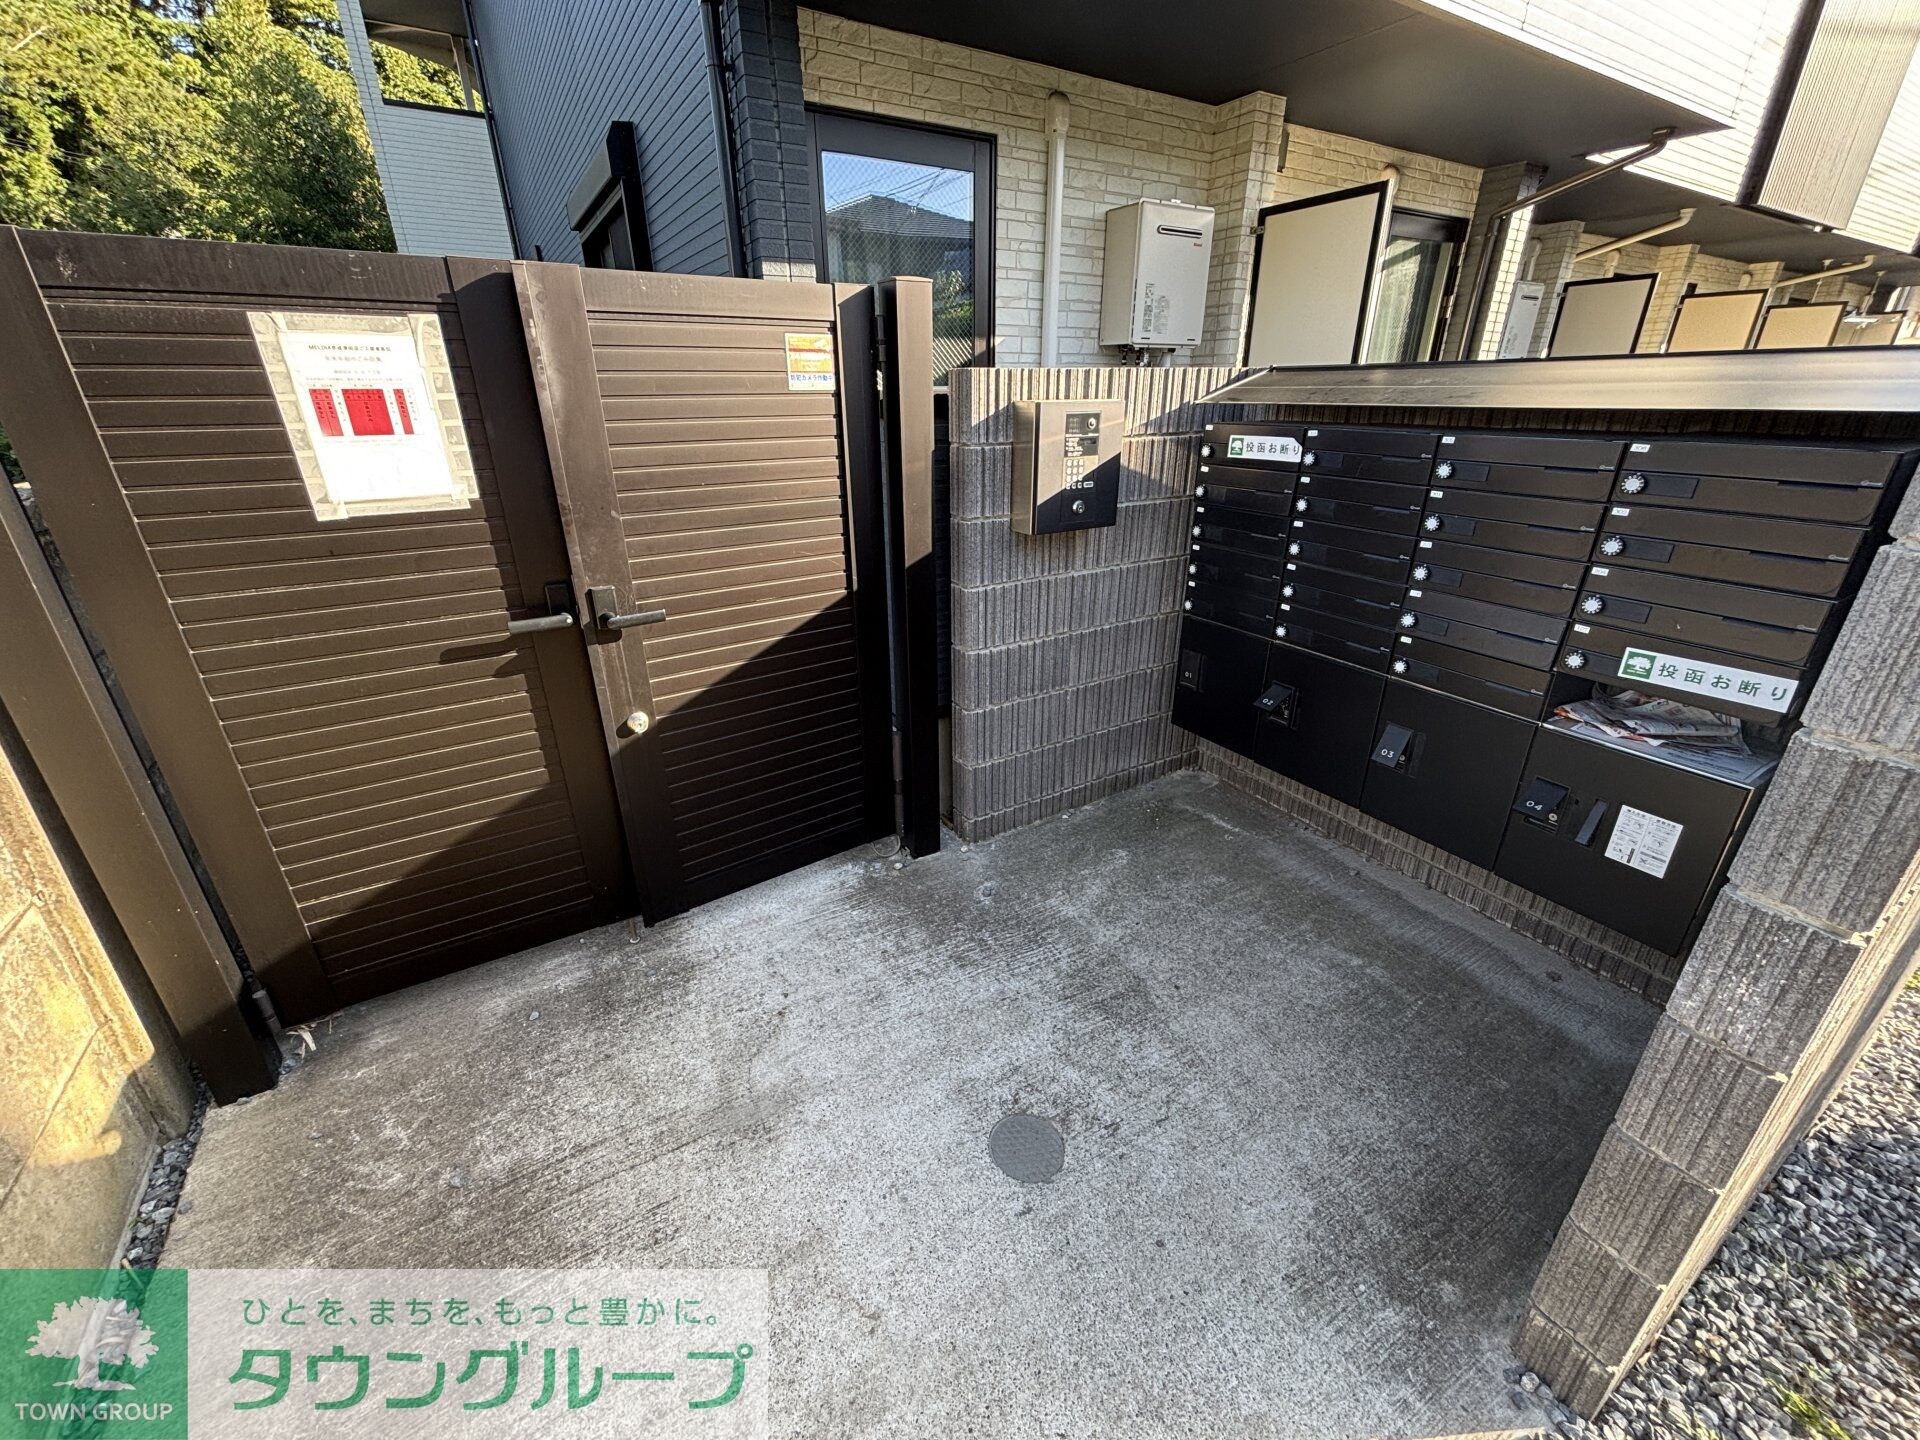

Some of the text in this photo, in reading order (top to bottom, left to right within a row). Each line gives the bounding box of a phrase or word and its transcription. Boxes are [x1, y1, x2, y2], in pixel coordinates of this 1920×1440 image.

[1245, 441, 1301, 455] 投函お断り
[1657, 662, 1788, 701] 投函お断り
[1262, 698, 1274, 706] 02
[1381, 748, 1395, 758] 03
[1526, 800, 1543, 811] 04
